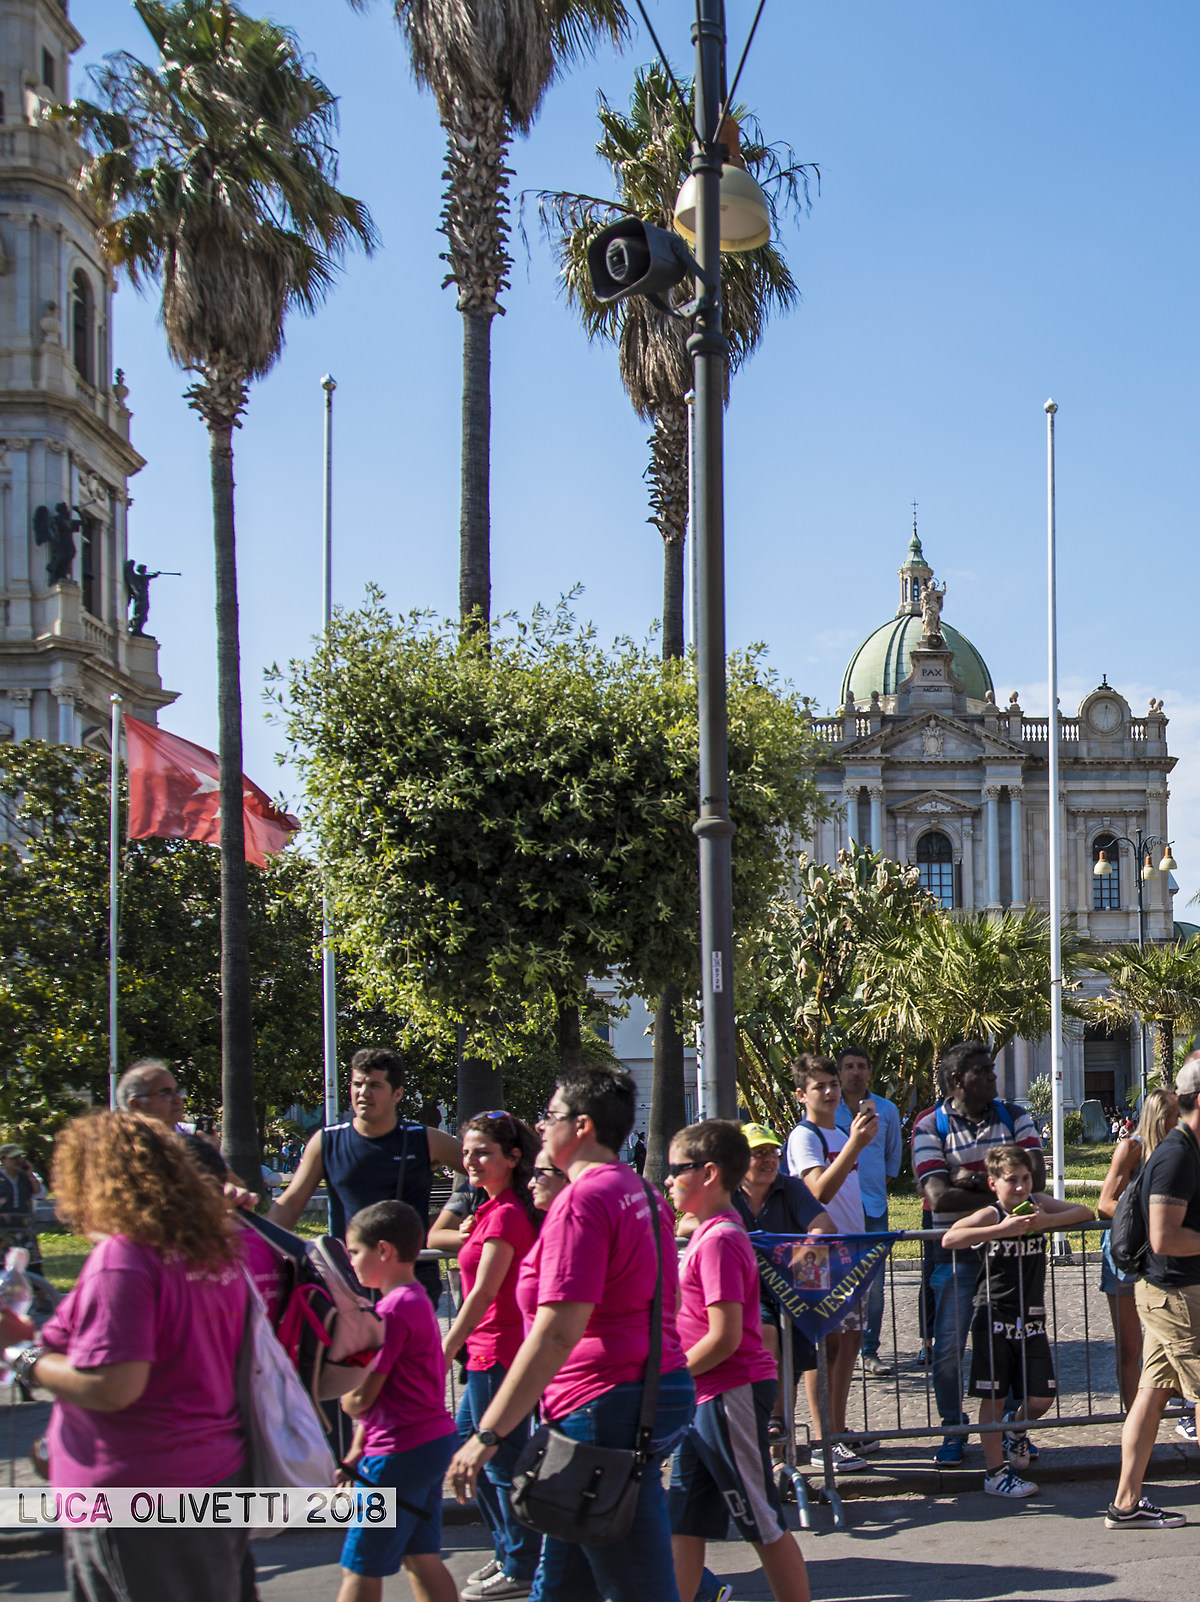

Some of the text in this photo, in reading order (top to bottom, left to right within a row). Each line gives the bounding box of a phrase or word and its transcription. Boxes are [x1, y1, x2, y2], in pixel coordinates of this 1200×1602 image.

[921, 668, 943, 677] PAX
[756, 1242, 887, 1319] TINELLE VESUVIANE
